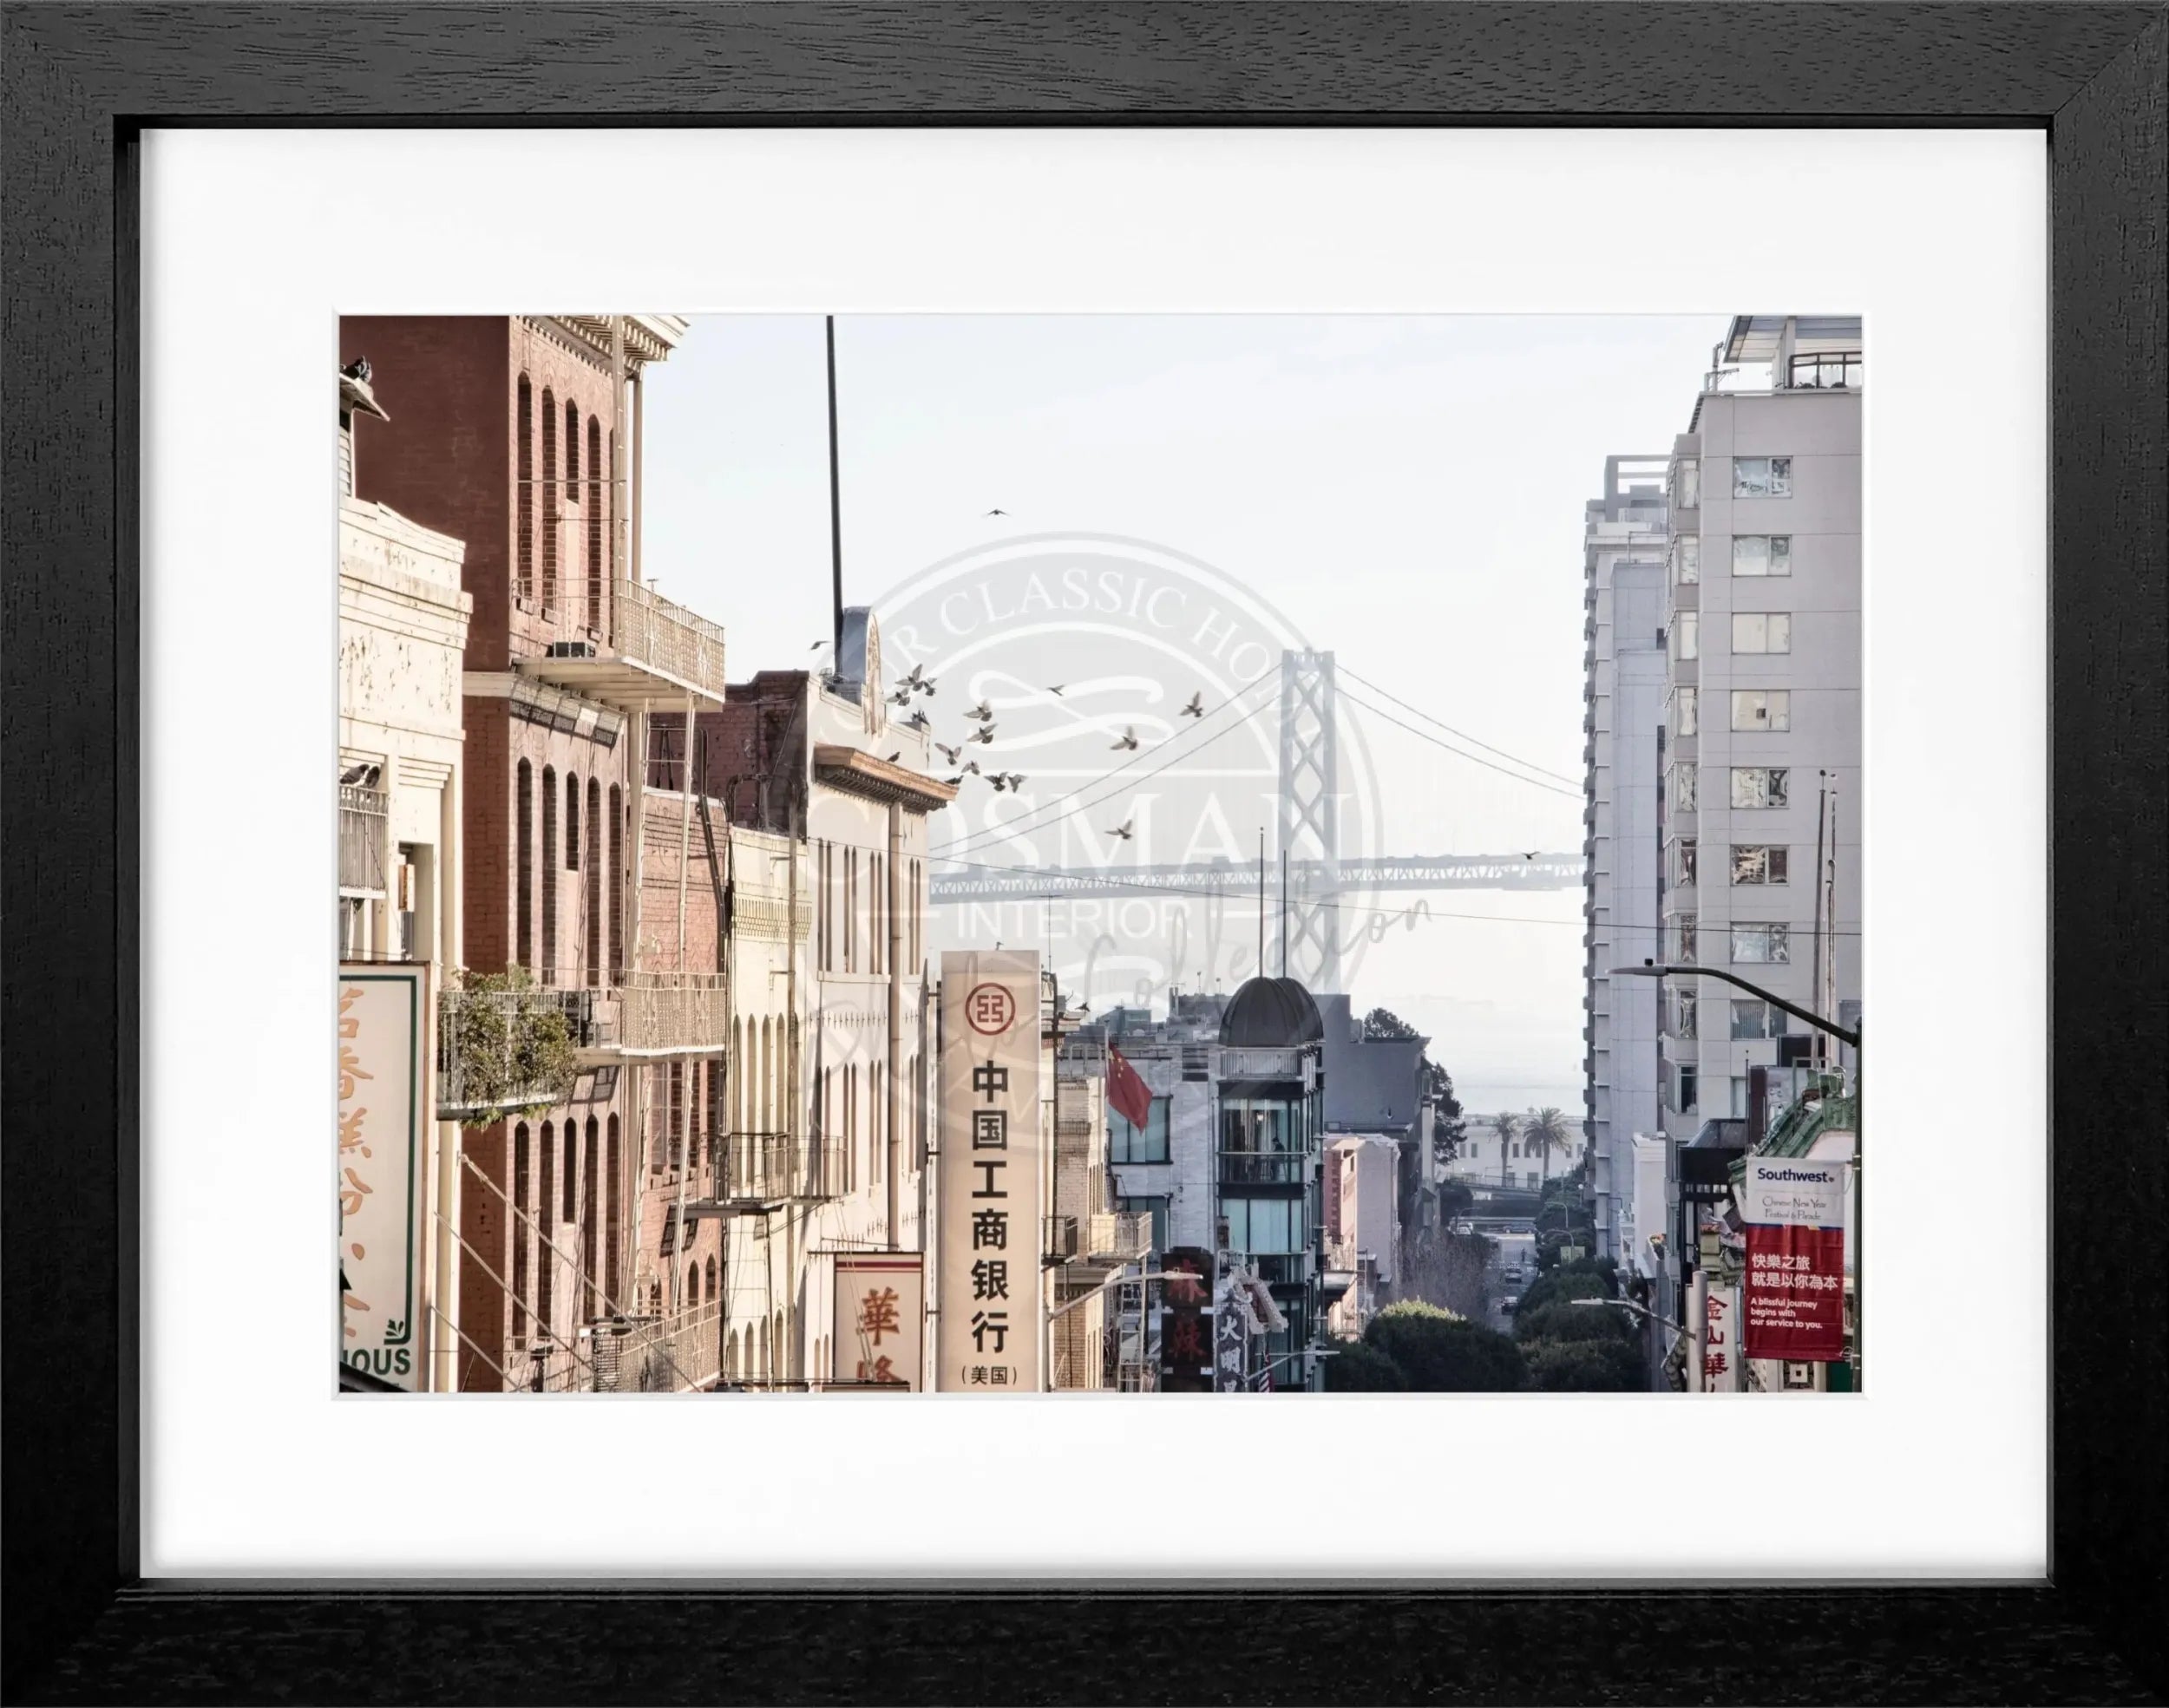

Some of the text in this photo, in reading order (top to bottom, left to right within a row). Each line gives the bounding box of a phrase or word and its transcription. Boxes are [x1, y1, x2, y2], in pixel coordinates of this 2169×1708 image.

[1758, 1168, 1828, 1183] Southwest
[971, 1059, 1009, 1354] 中国工商银行
[1752, 1253, 1811, 1271] 快樂之旅
[1752, 1271, 1838, 1291] 就是以你為本
[1759, 1298, 1786, 1306] blissful
[1786, 1299, 1818, 1310] journey
[1751, 1307, 1776, 1317] begins
[1766, 1319, 1793, 1327] service
